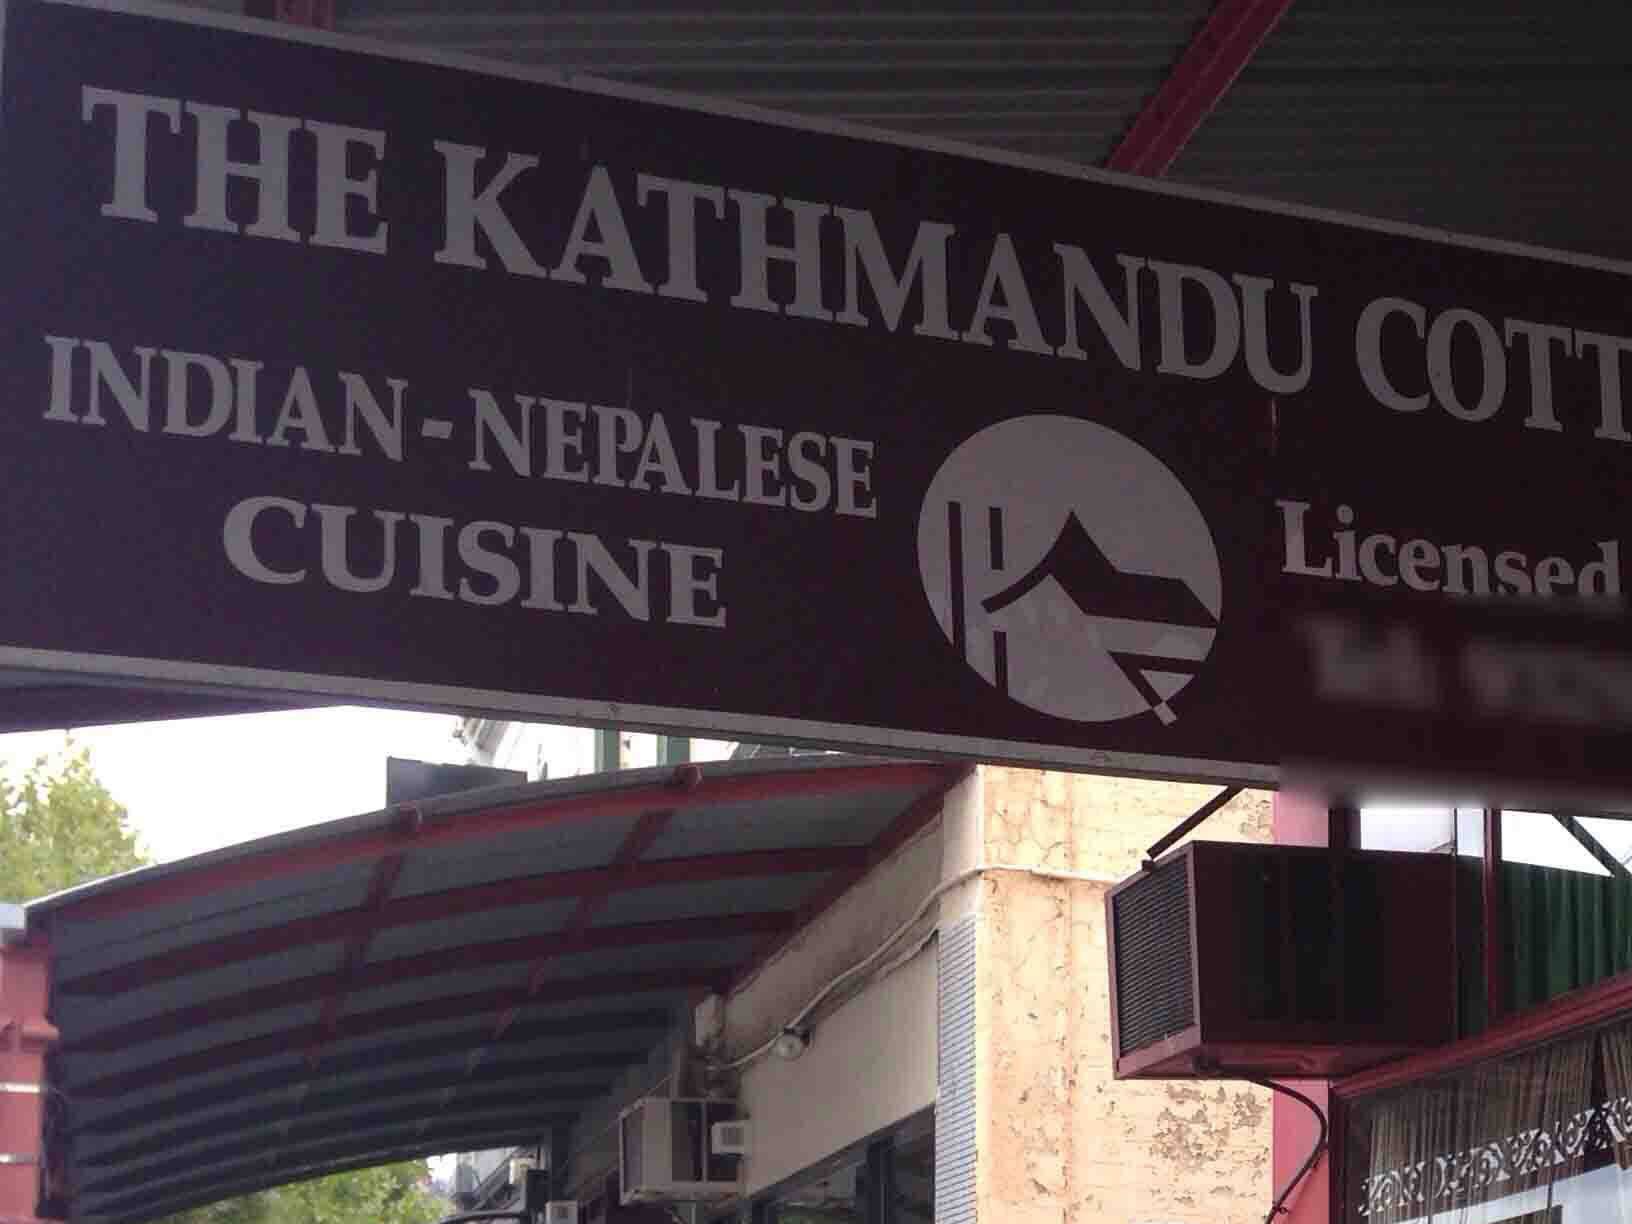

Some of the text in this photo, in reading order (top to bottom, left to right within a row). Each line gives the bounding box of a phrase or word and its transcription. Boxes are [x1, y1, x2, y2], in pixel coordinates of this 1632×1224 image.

[82, 84, 389, 256] THE
[433, 138, 1318, 395] KATHMANDU
[223, 494, 728, 630] CUISINE
[1275, 498, 1621, 606] Licensed
